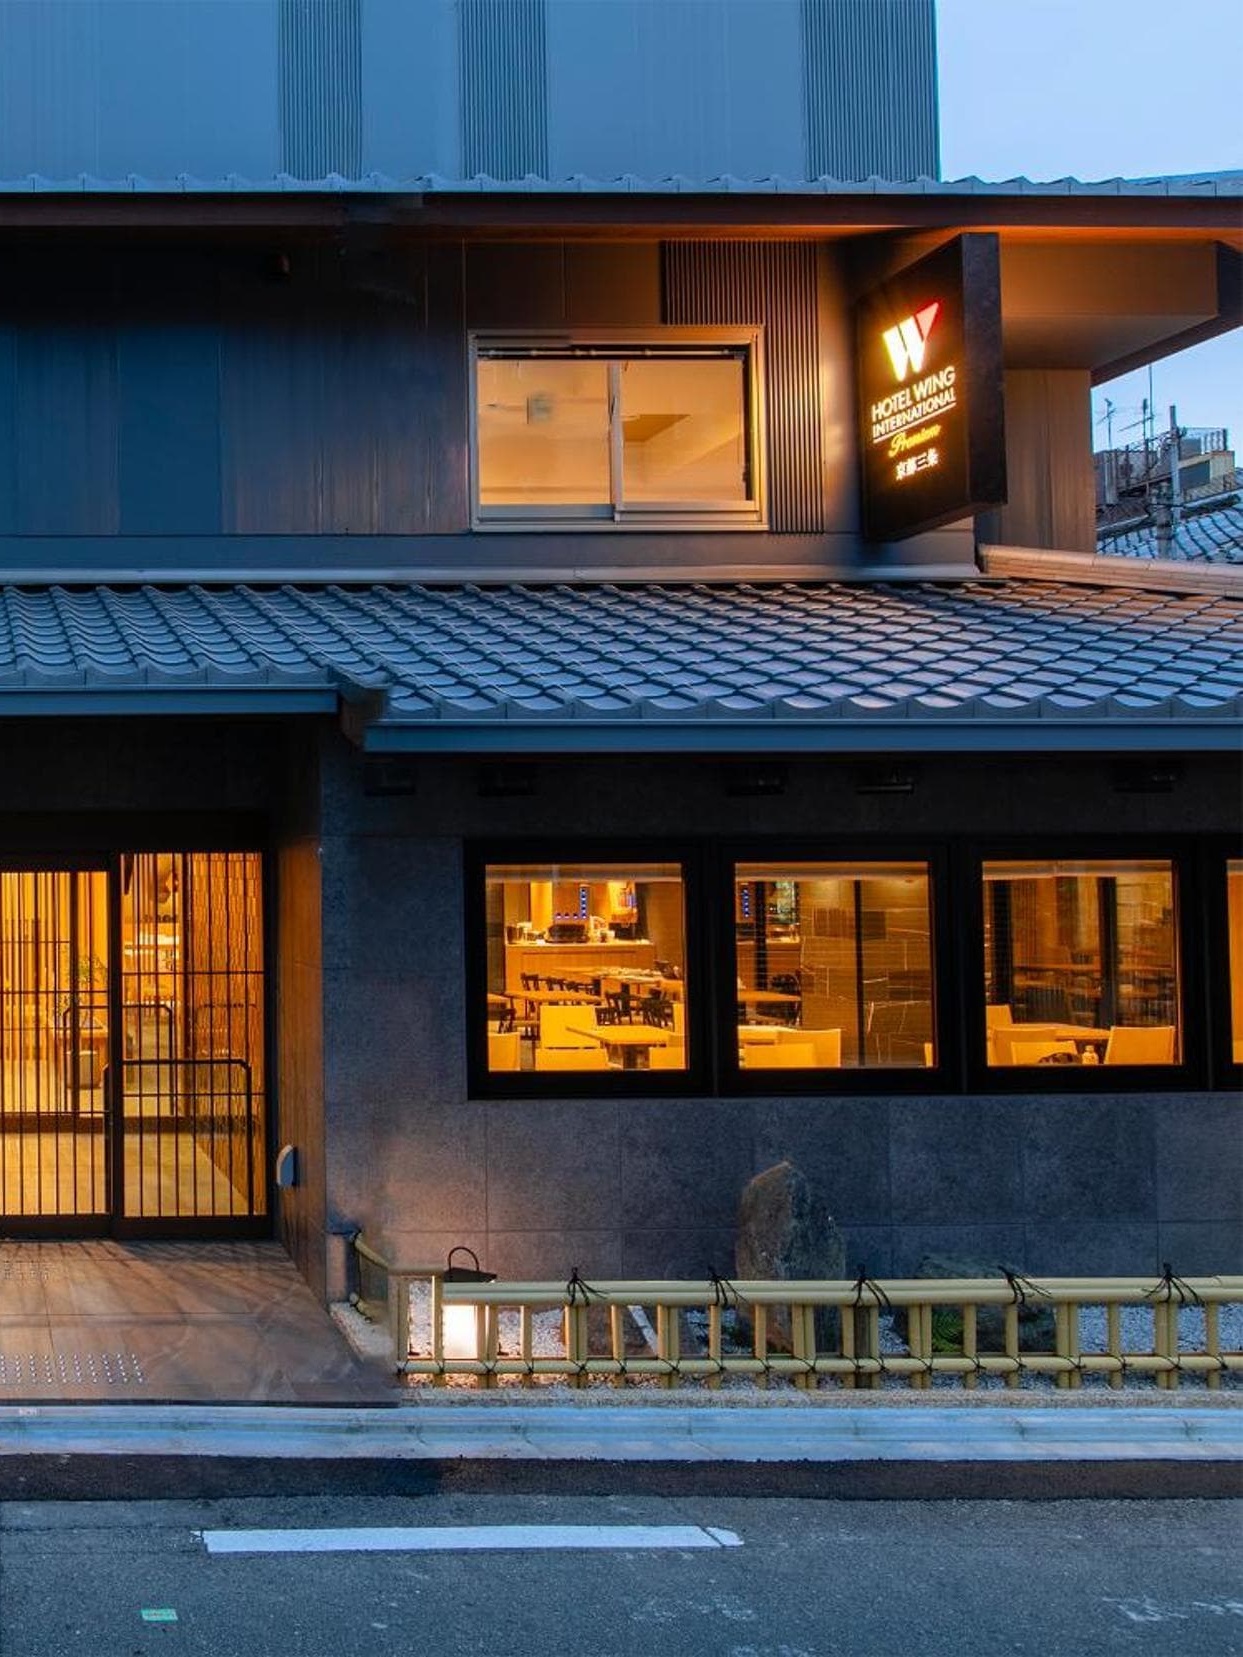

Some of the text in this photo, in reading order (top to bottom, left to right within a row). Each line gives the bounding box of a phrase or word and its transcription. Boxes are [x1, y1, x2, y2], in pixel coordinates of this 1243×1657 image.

[872, 366, 955, 421] HOTEL WING
[872, 388, 956, 437] INTERNATIONAL
